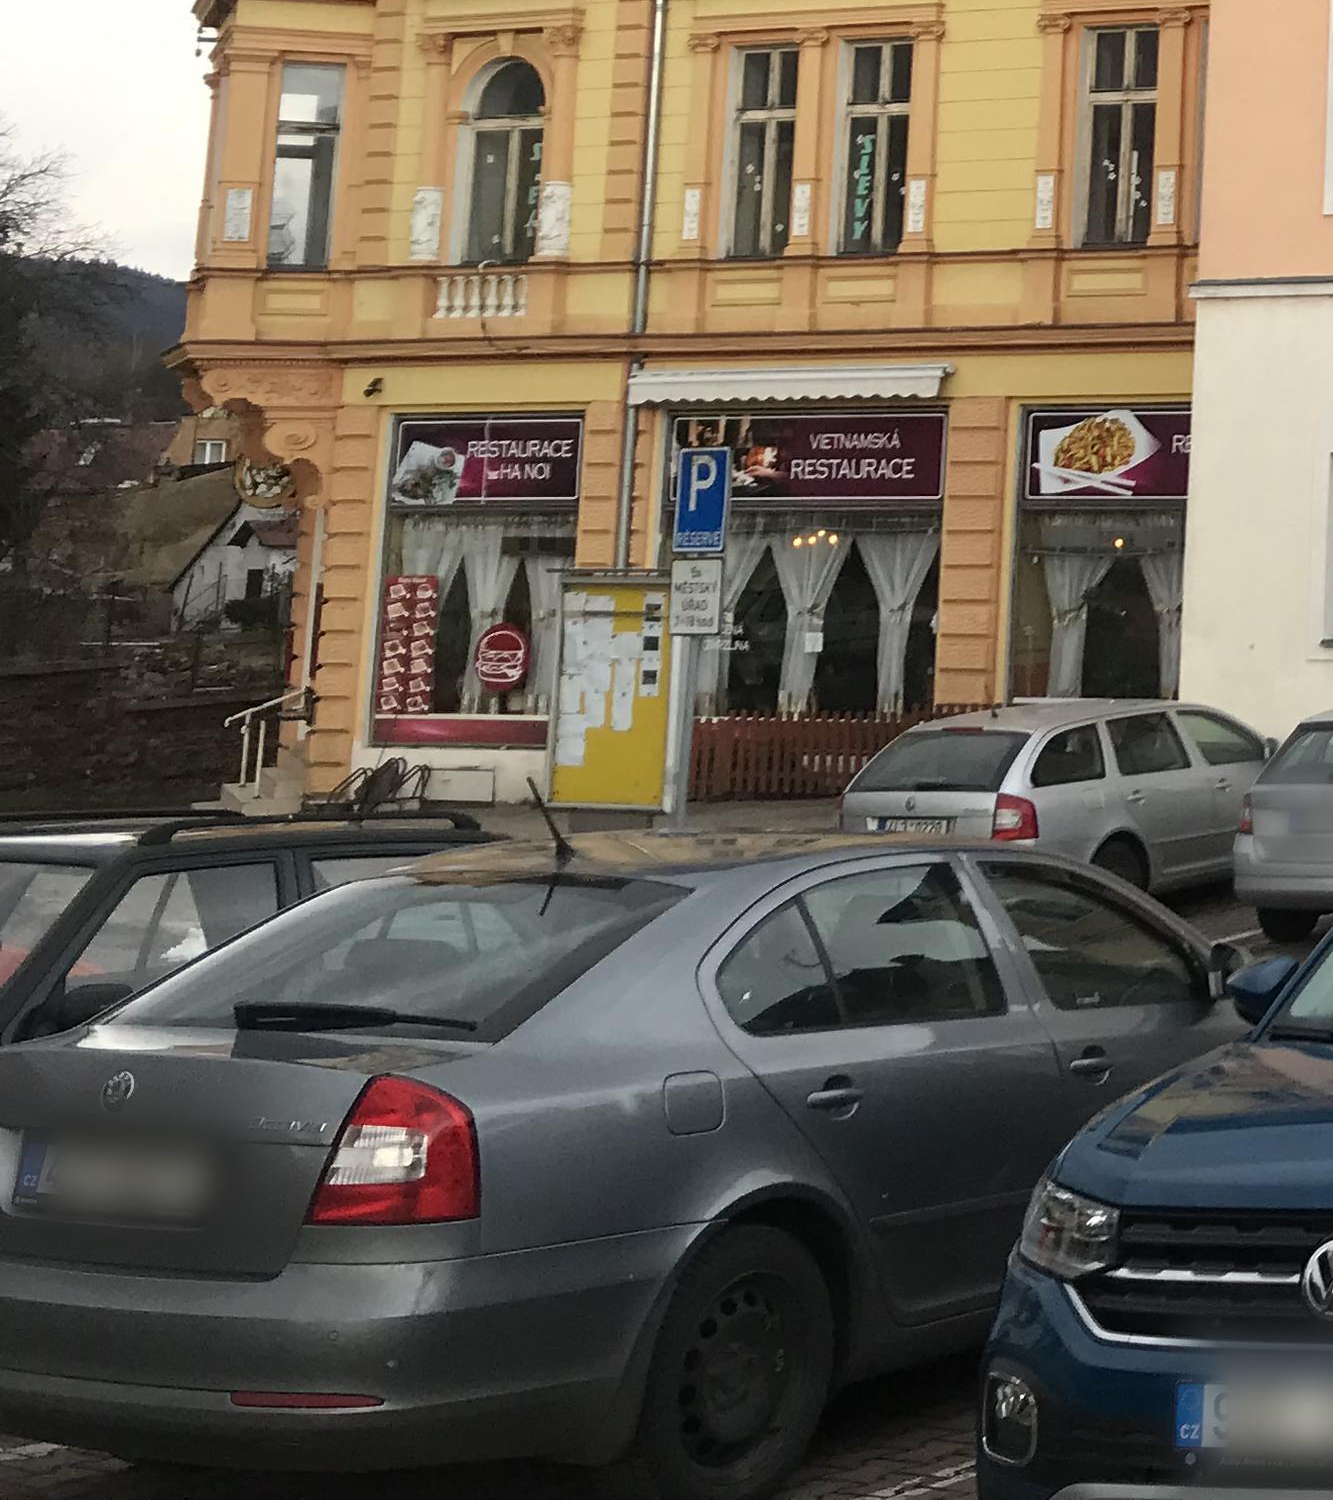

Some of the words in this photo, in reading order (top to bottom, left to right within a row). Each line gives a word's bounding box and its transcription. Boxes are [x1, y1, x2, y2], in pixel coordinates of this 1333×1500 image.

[809, 428, 902, 449] VIETNAMSKÁ
[466, 439, 574, 459] RESTAURACE
[500, 463, 521, 480] HA
[523, 462, 551, 480] NOI
[790, 458, 916, 480] RESTAURACE
[688, 455, 717, 512] P
[1180, 1423, 1200, 1440] CZ
